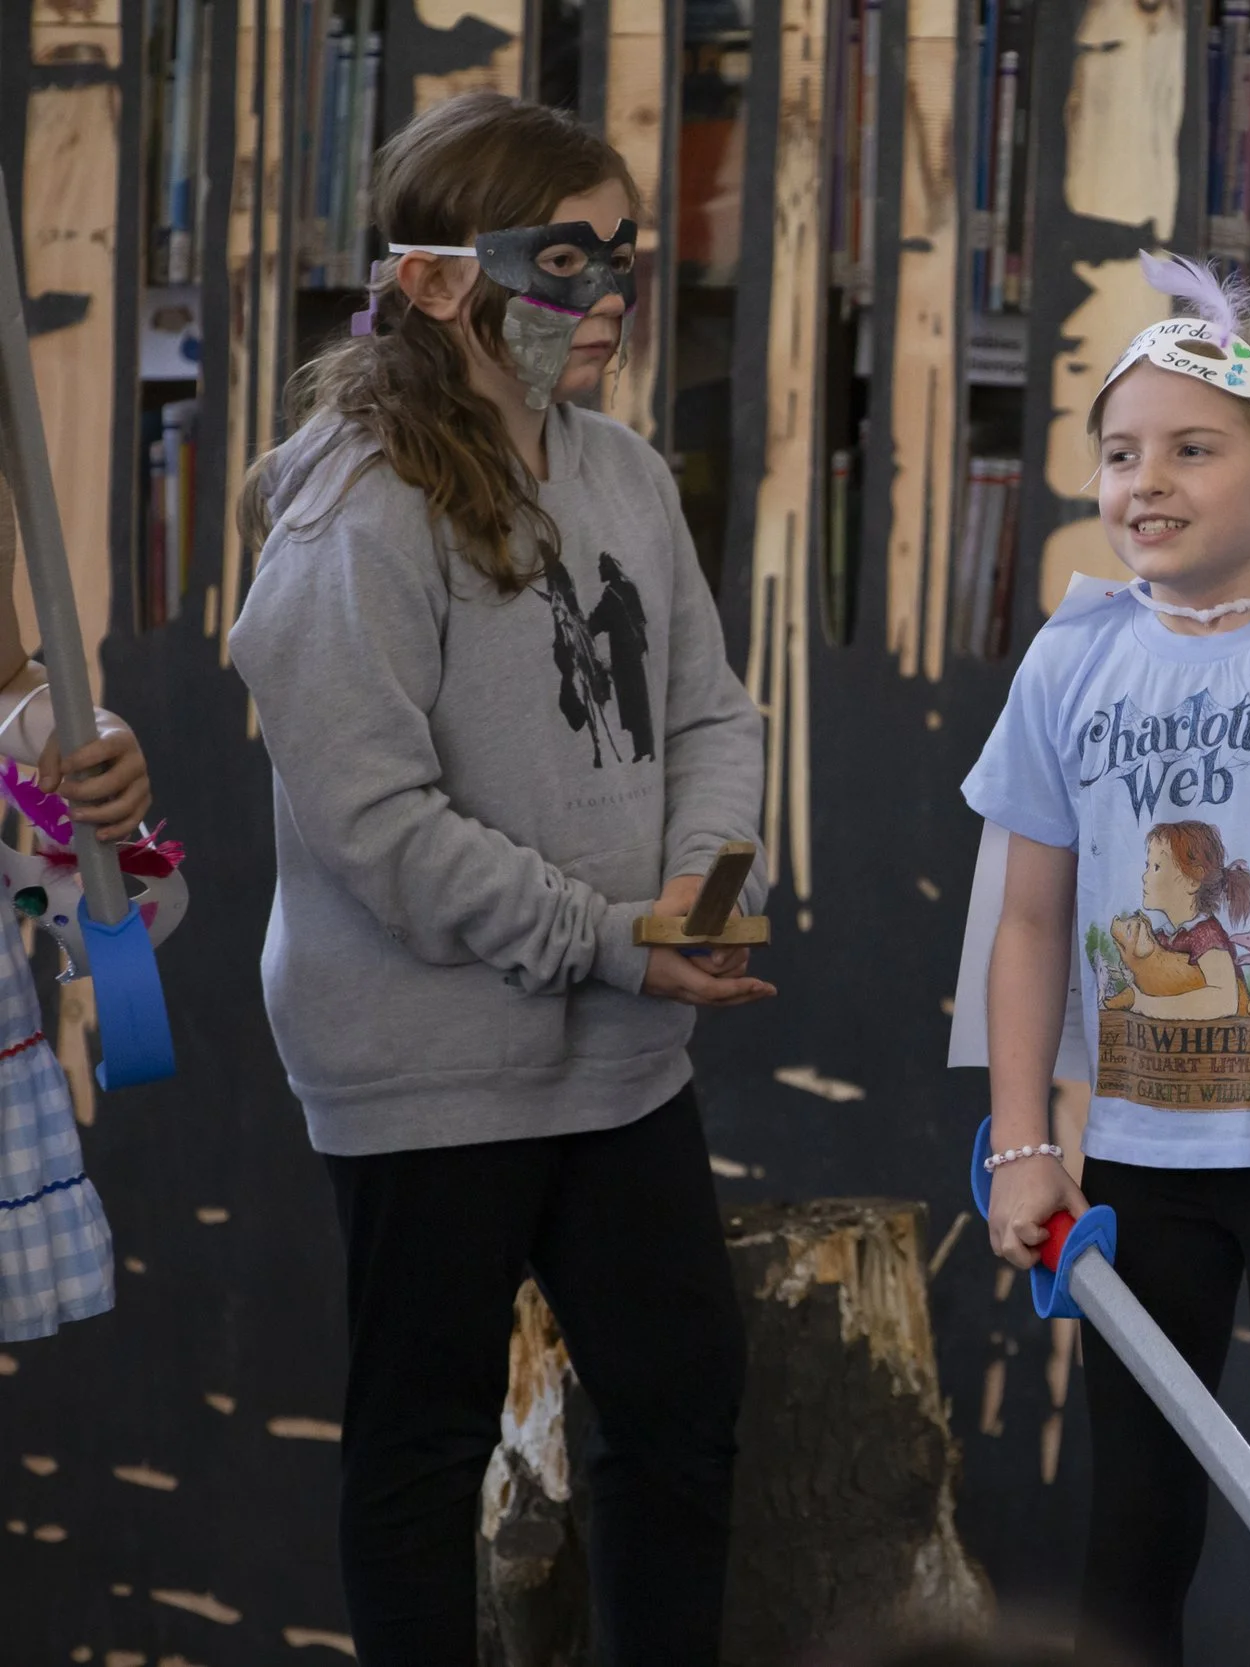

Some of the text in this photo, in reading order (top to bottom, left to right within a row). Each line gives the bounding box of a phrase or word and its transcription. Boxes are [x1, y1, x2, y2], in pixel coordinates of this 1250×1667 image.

[1117, 745, 1234, 826] Web
[1150, 1024, 1249, 1054] WHITE
[1138, 1056, 1201, 1074] STUART
[1137, 1079, 1191, 1104] GARTH
